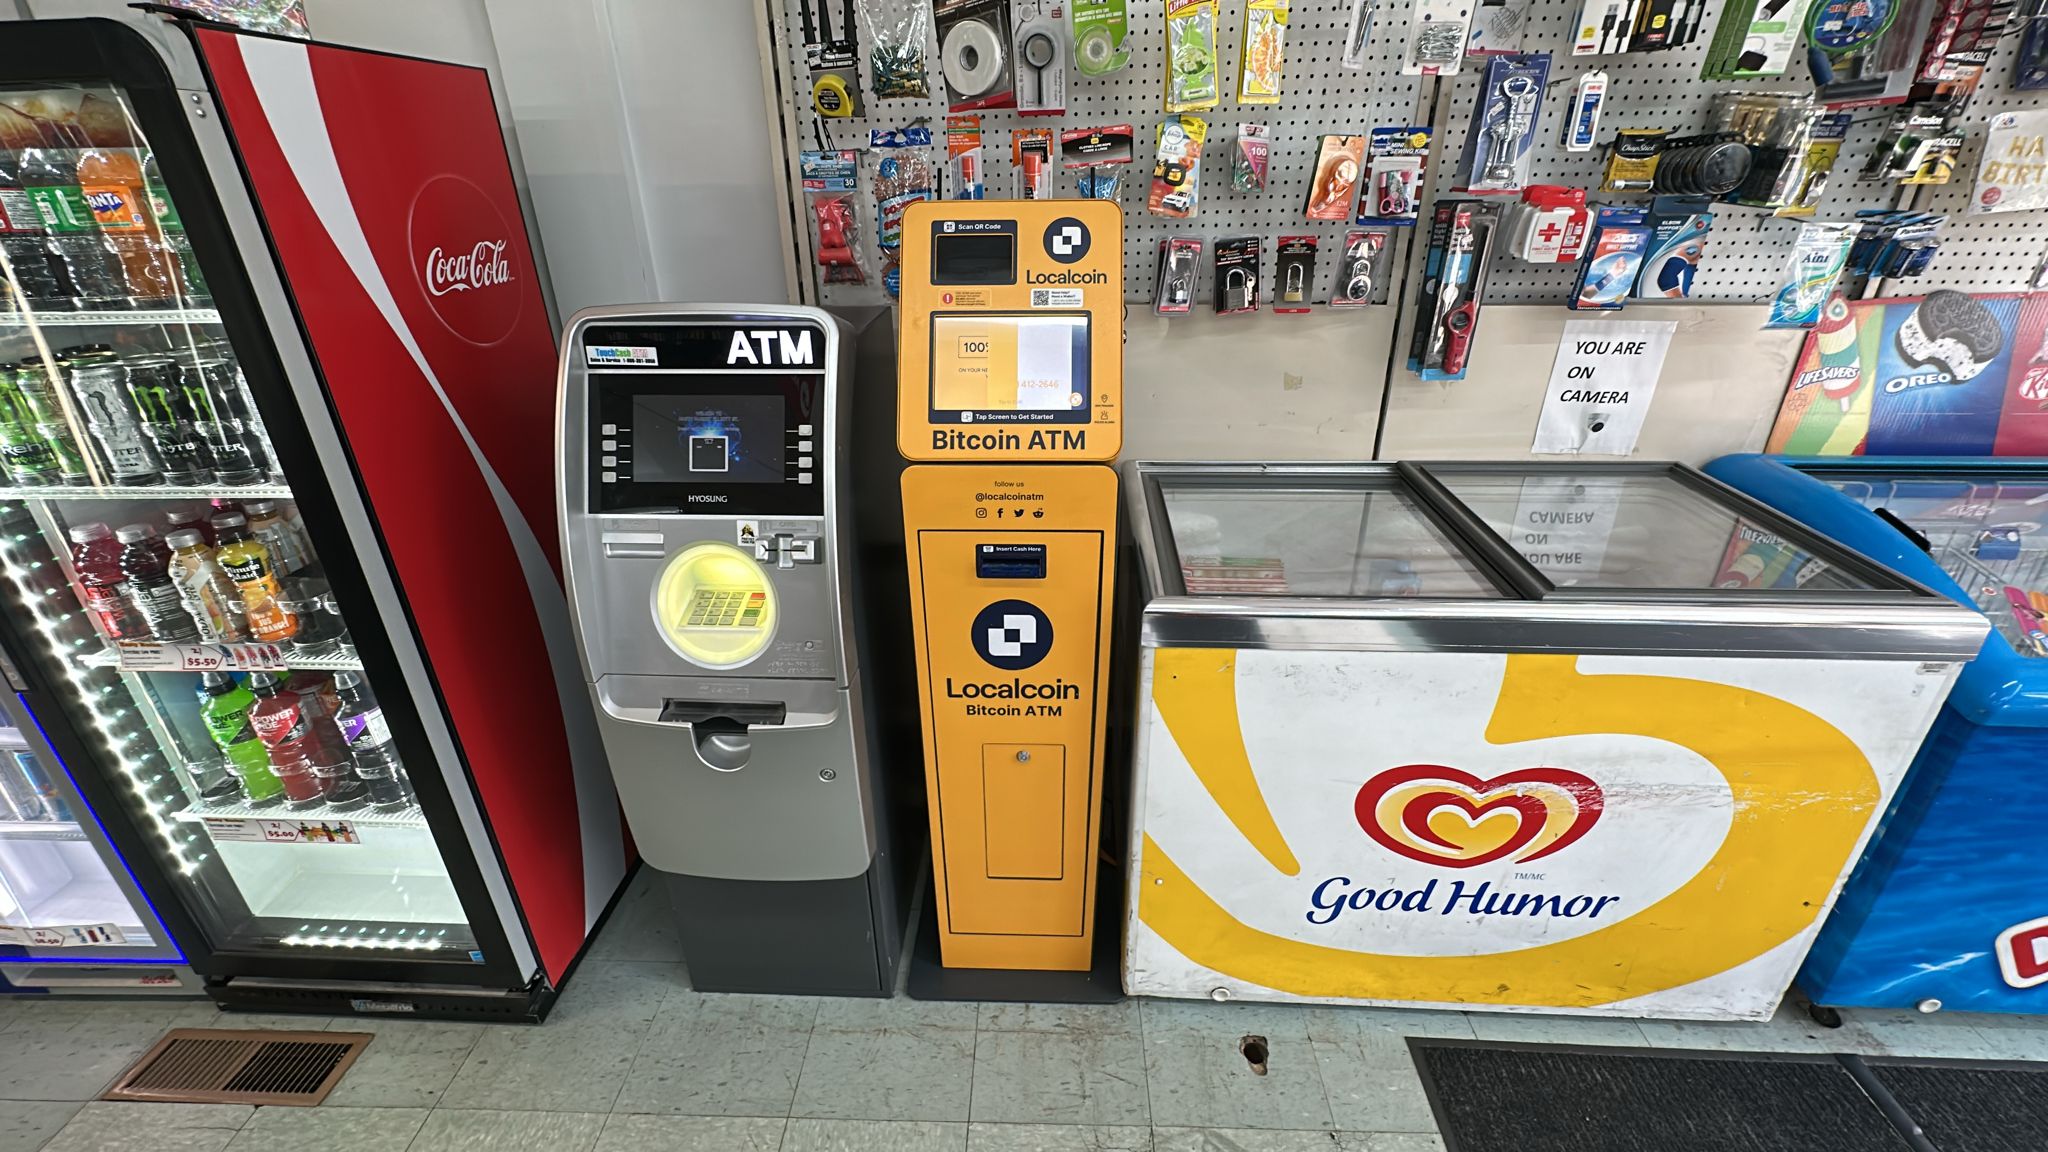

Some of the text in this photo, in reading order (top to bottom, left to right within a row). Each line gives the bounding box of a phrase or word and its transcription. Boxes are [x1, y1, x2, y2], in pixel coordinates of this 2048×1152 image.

[1251, 147, 1267, 156] 100
[1621, 143, 1657, 152] ChapStick
[844, 178, 855, 186] 30
[426, 240, 509, 296] Coca-Cola
[1026, 269, 1107, 284] Localcoin
[726, 331, 814, 365] ATM
[1575, 341, 1647, 355] YOU ARE
[1567, 366, 1596, 379] ON
[1795, 366, 1860, 390] LIFESAVERS
[1885, 373, 1952, 395] OREO
[1560, 389, 1629, 404] CAMERA
[932, 429, 1086, 450] Bitcoin ATM
[688, 494, 728, 503] HYOSUNG
[975, 492, 1044, 502] @localcoinatm
[946, 677, 1080, 700] Localcoin
[966, 704, 1062, 717] Bitcoin ATM
[1514, 872, 1546, 881] TM/MC
[1306, 876, 1620, 924] Good Humor
